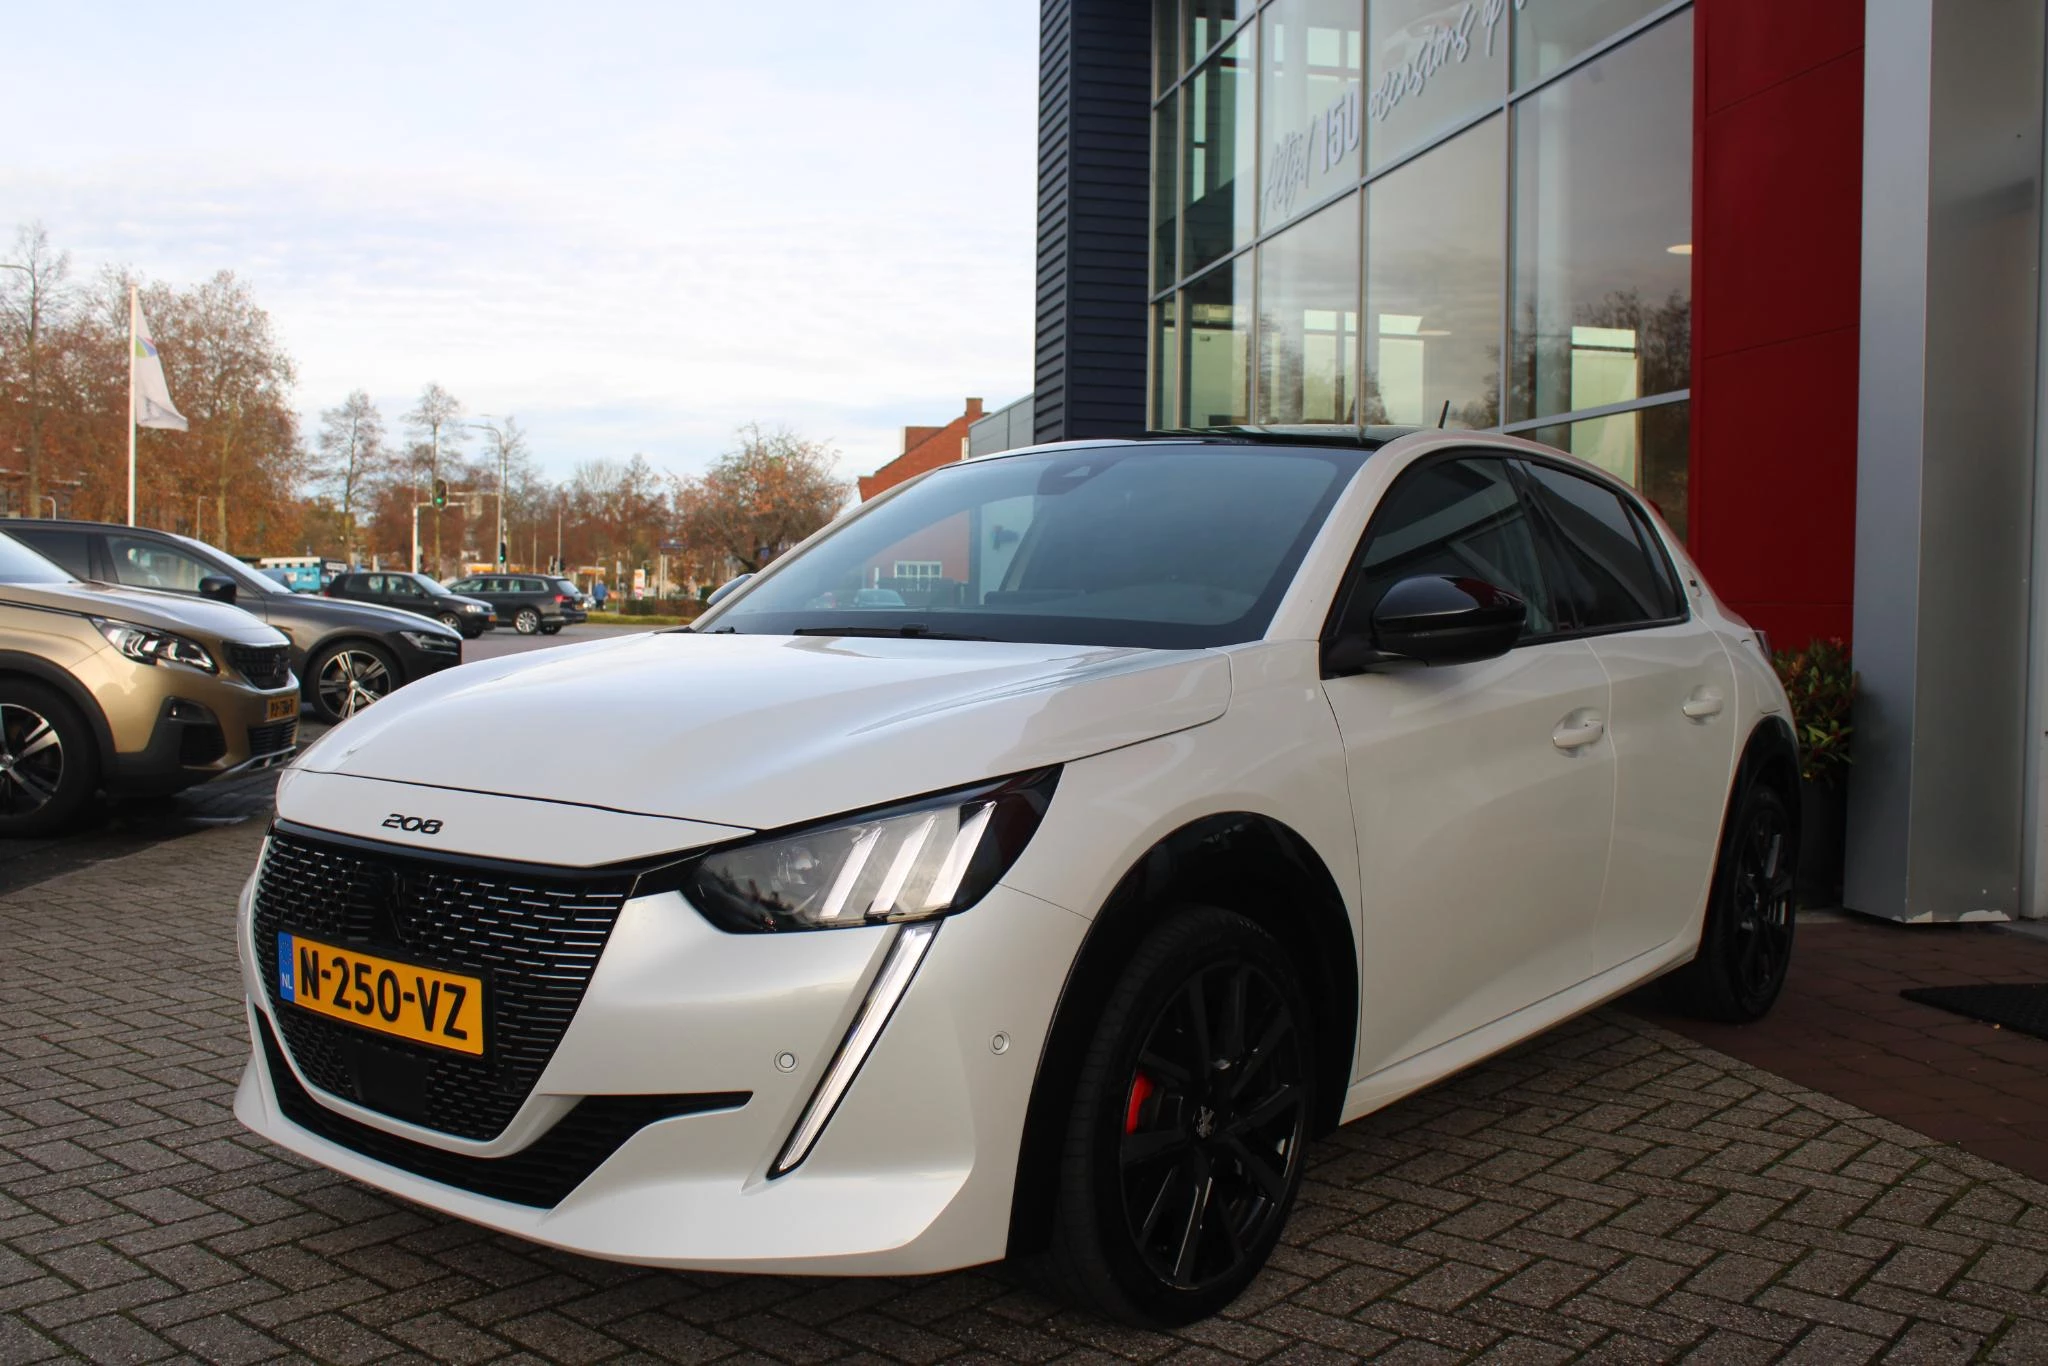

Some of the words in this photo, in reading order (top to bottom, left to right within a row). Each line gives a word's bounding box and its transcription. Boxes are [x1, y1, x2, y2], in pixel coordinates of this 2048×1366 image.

[1319, 82, 1360, 175] 150
[382, 813, 444, 834] 208
[281, 972, 293, 990] NL
[300, 947, 468, 1041] N-250-VZ
